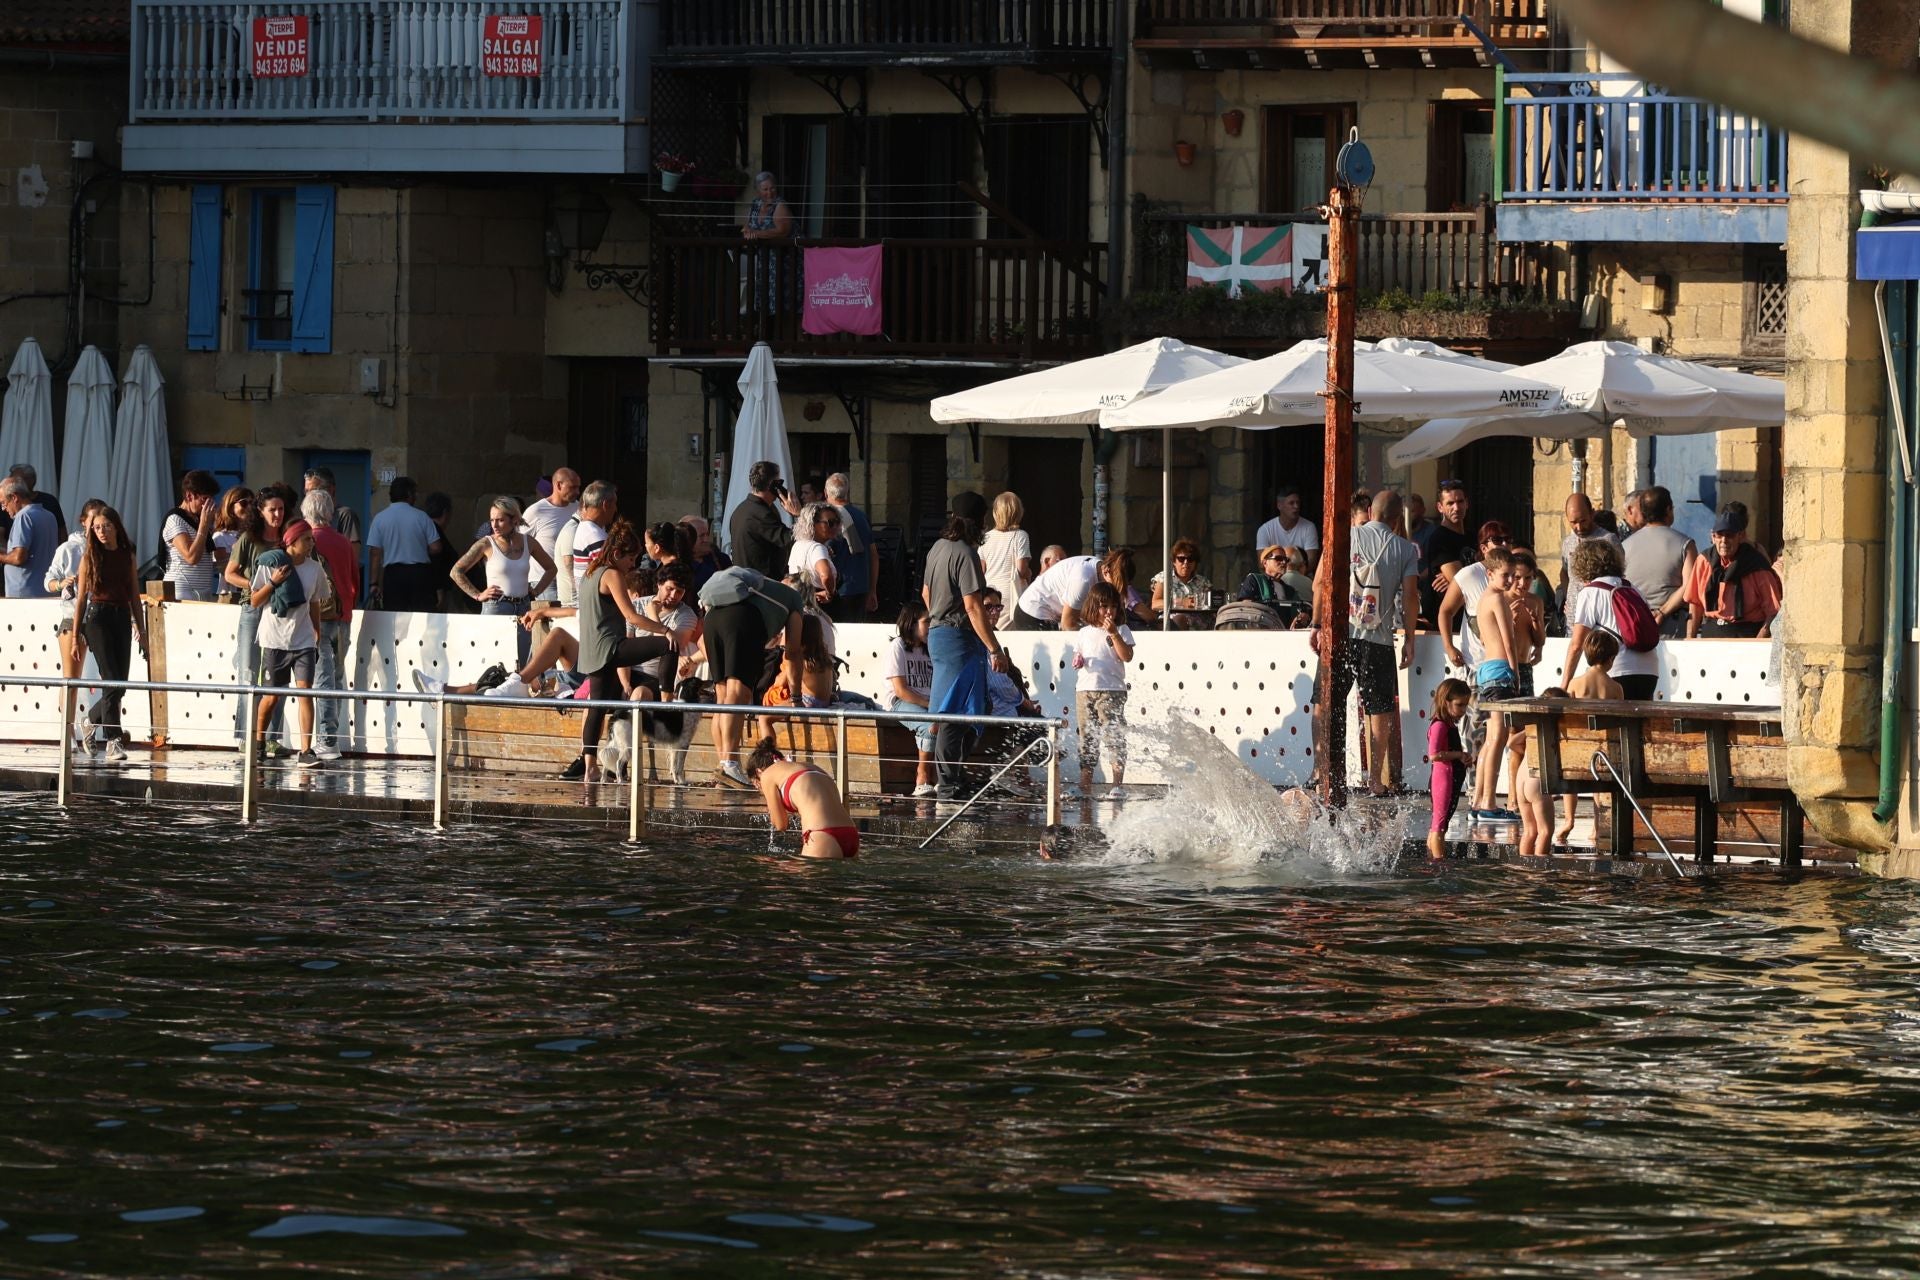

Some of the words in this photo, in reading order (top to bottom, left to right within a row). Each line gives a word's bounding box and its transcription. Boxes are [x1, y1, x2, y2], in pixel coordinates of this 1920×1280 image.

[255, 39, 306, 57] VENDE
[484, 39, 539, 55] SALGAI
[256, 59, 271, 75] 943
[273, 58, 288, 74] 523
[290, 57, 305, 73] 694
[486, 57, 501, 73] 943
[504, 57, 519, 73] 523
[522, 57, 538, 73] 694
[1499, 389, 1550, 402] AMSTEL
[907, 660, 933, 675] PARIS
